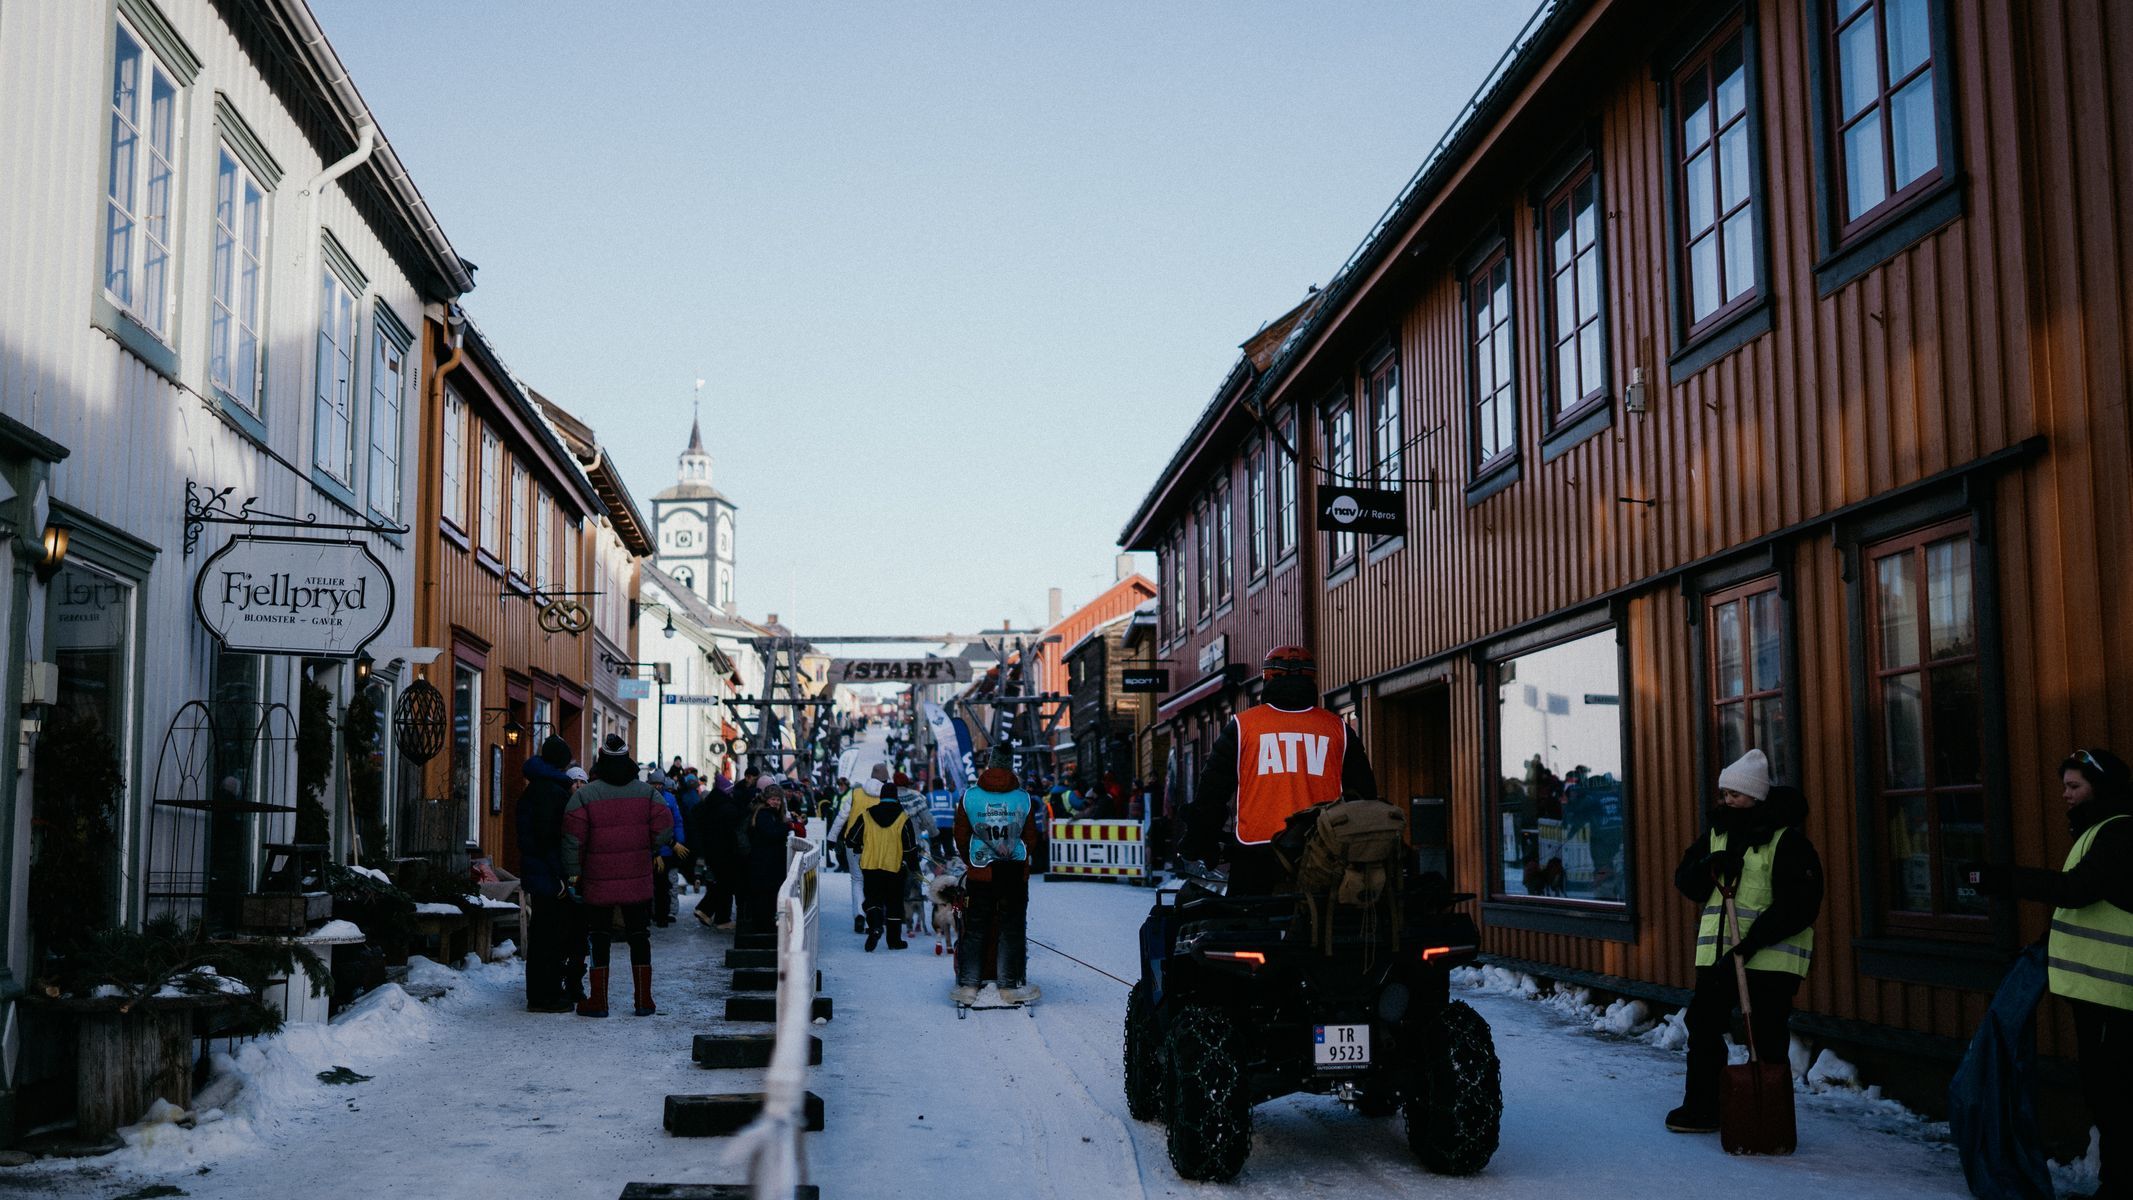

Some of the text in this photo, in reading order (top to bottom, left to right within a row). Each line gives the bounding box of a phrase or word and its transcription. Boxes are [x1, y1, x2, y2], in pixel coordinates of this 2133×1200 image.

[1334, 507, 1396, 520] nav Røros
[304, 576, 345, 587] ATELIER
[221, 571, 367, 616] Fjellpryd
[243, 613, 344, 627] BLOMSTER GAVER
[855, 661, 944, 680] START
[679, 695, 710, 704] Automat
[1257, 732, 1330, 777] ATV
[986, 825, 1009, 841] 164
[1338, 1027, 1355, 1043] TR
[1329, 1045, 1364, 1061] 9523
